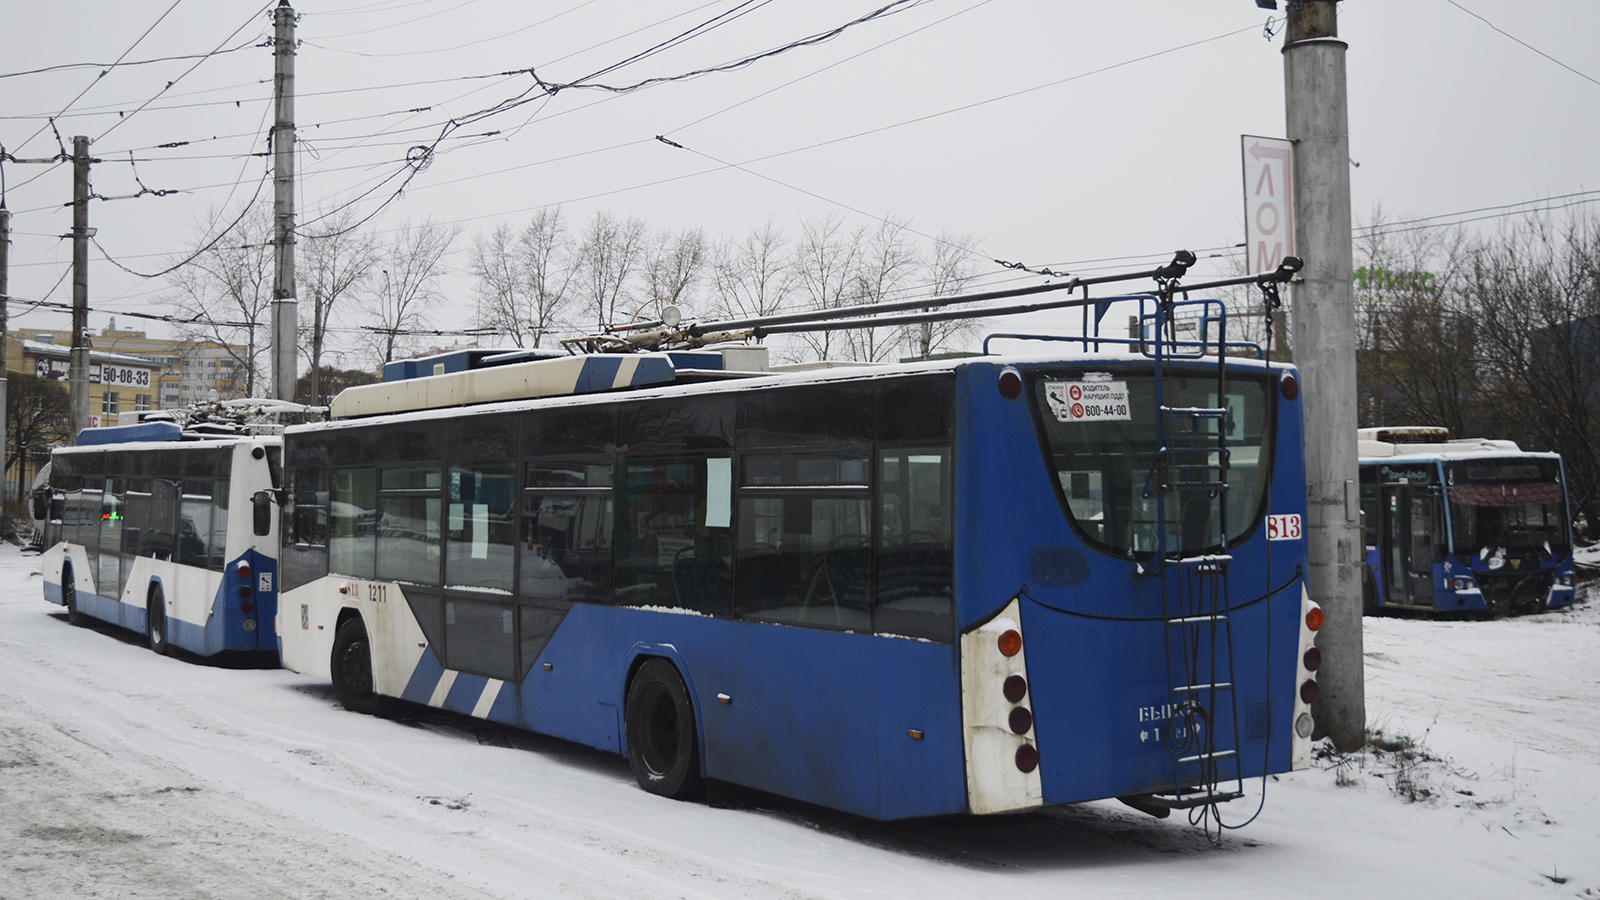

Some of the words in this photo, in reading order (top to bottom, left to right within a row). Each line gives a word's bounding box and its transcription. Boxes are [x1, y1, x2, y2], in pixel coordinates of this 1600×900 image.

[1254, 163, 1282, 274] ЛОМ
[103, 367, 149, 385] 50-08-33
[1085, 404, 1127, 417] 600-44-00
[1268, 516, 1300, 539] 813
[347, 582, 359, 597] 813
[368, 583, 387, 603] 1211
